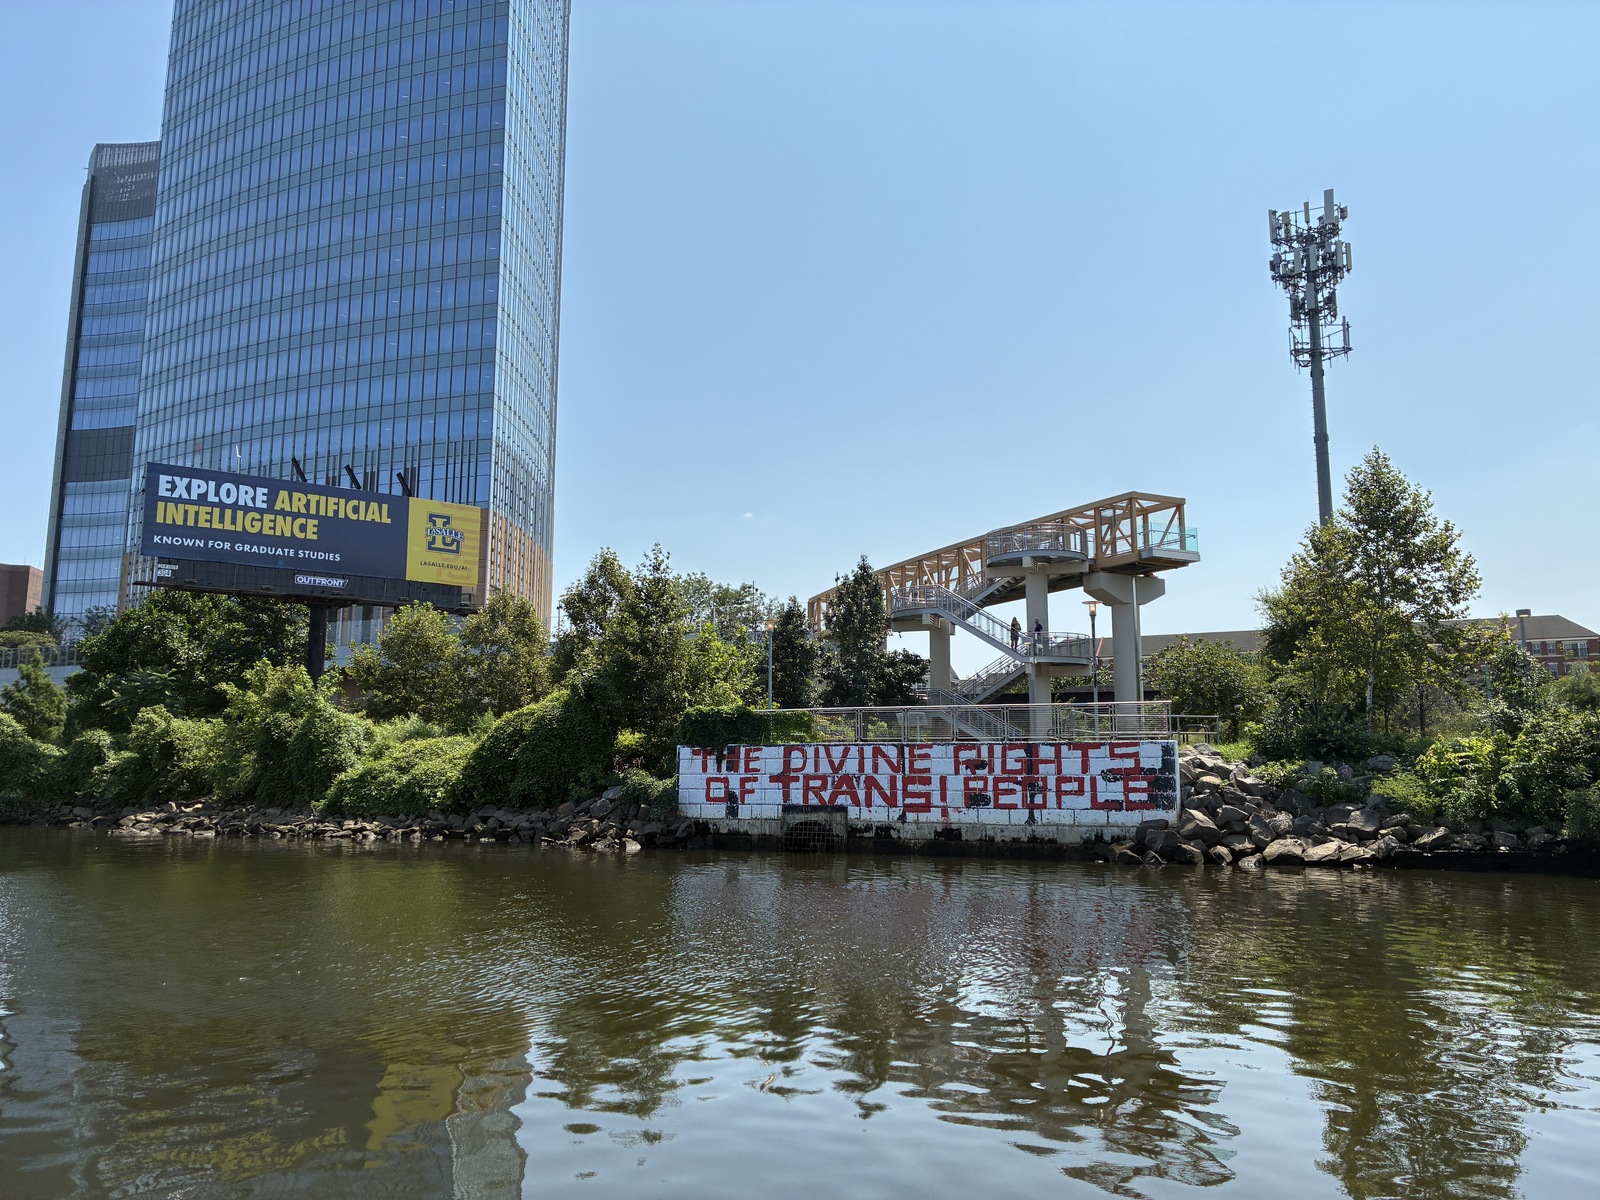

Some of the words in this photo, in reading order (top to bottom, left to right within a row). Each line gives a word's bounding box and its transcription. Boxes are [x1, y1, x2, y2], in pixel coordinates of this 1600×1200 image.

[158, 474, 269, 509] EXPLORE
[274, 490, 392, 524] ARTIFICIAL
[156, 501, 319, 540] INTELLIGENCE
[153, 535, 204, 548] KNOWN
[208, 540, 231, 550] FOR
[234, 543, 296, 557] GRADUATE
[298, 550, 341, 561] STUDIES
[296, 576, 345, 587] OUTFRONT
[420, 561, 468, 571] LASALLE.EDU/AI
[692, 745, 763, 774] THE
[783, 744, 931, 775] DIVINE
[953, 743, 1141, 775] RIGHTS
[706, 776, 759, 804] OF
[963, 775, 1156, 811] PEOPLE
